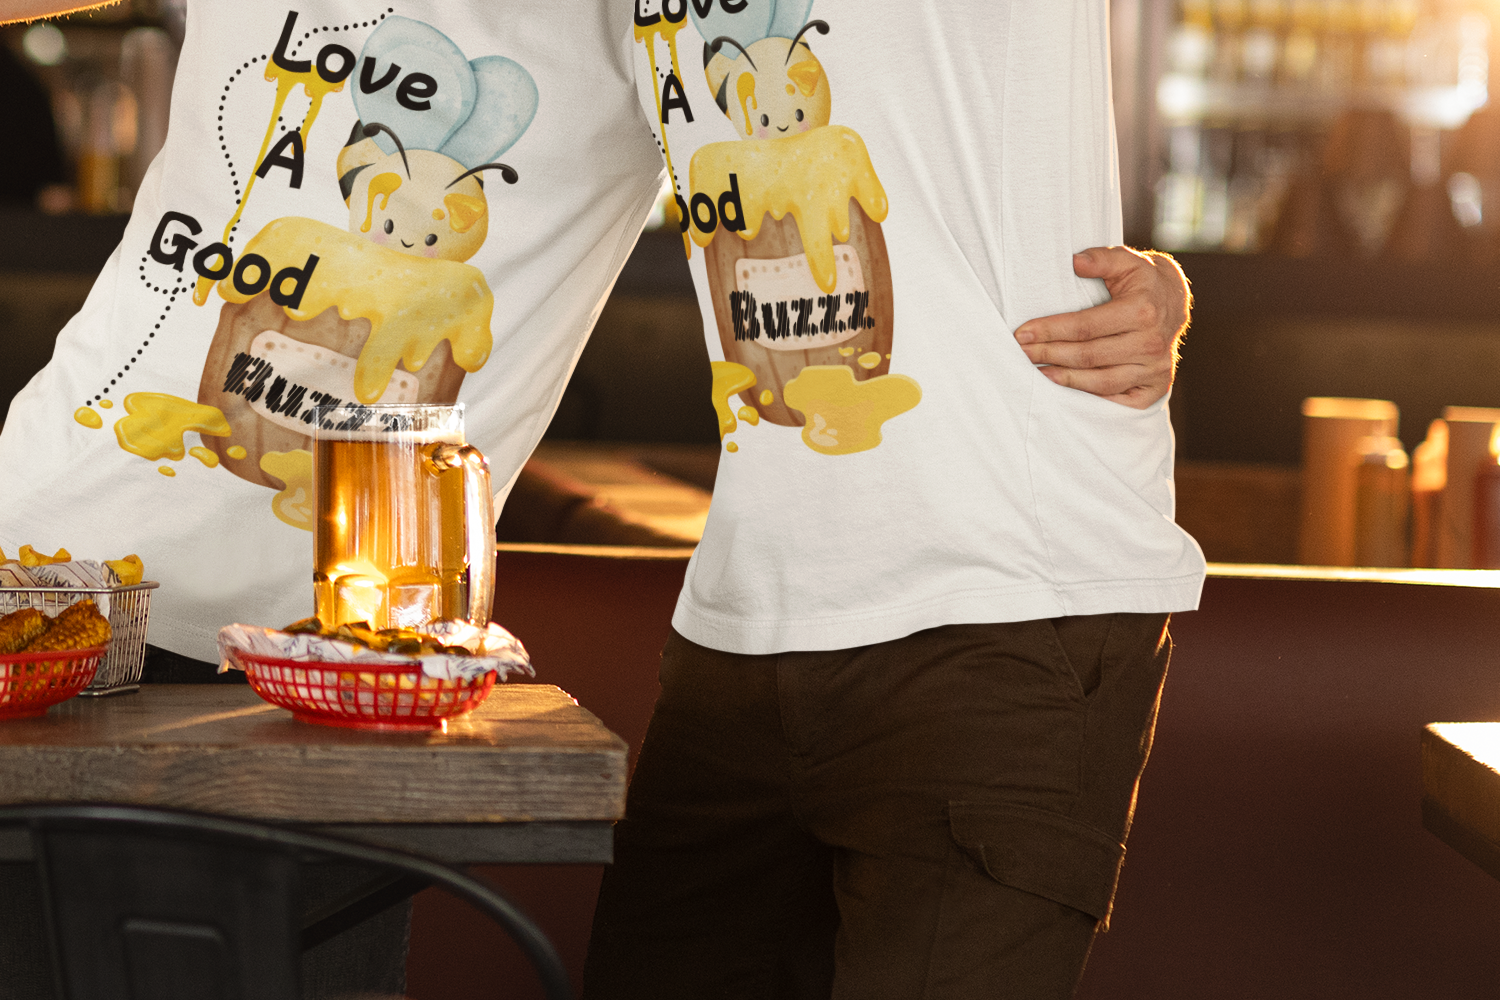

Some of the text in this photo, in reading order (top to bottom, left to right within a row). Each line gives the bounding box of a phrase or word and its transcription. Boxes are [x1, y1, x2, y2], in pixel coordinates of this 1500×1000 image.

[272, 10, 438, 111] Love
[660, 72, 694, 125] A
[255, 130, 304, 189] A
[674, 173, 747, 233] ood
[149, 211, 320, 310] Good
[729, 289, 875, 342] Buzzz
